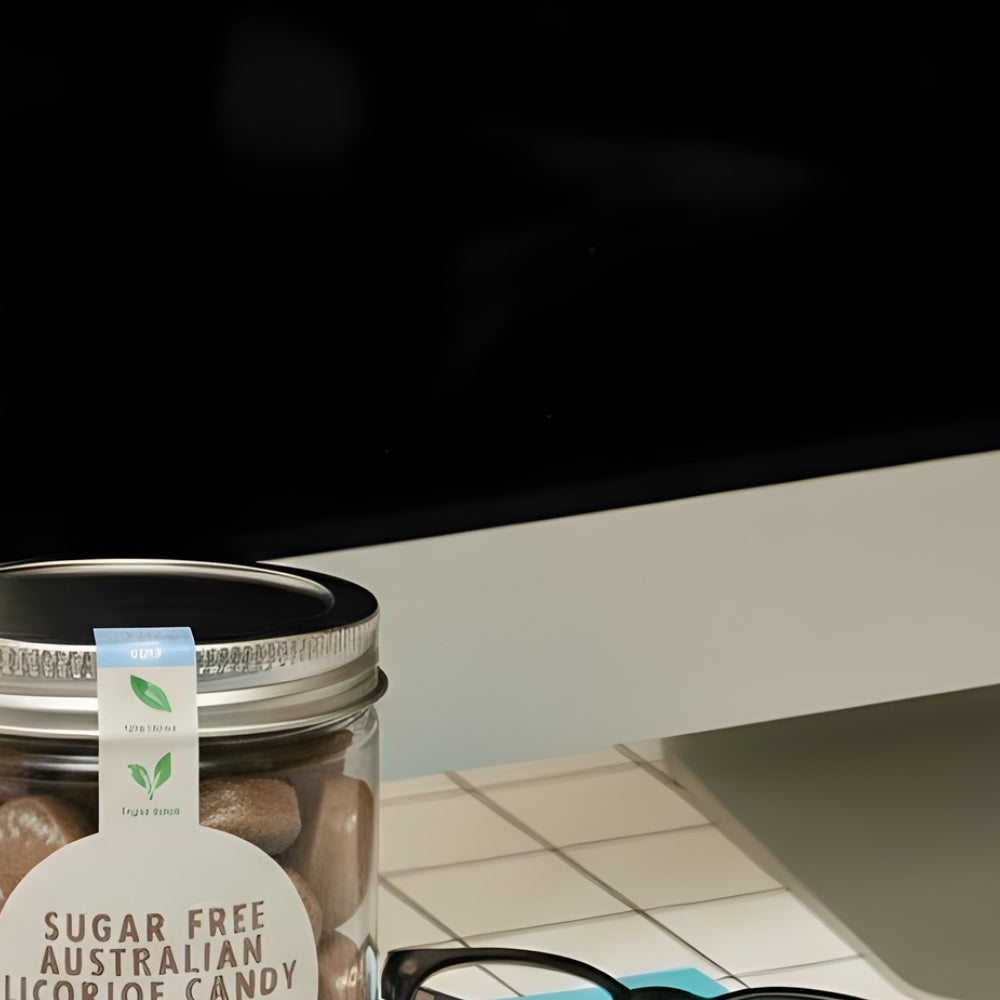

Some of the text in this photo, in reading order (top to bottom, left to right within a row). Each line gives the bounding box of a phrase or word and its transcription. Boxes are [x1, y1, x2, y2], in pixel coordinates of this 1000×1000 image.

[44, 900, 265, 943] SUGAR FREE
[40, 934, 262, 977] AUSTRALIAN
